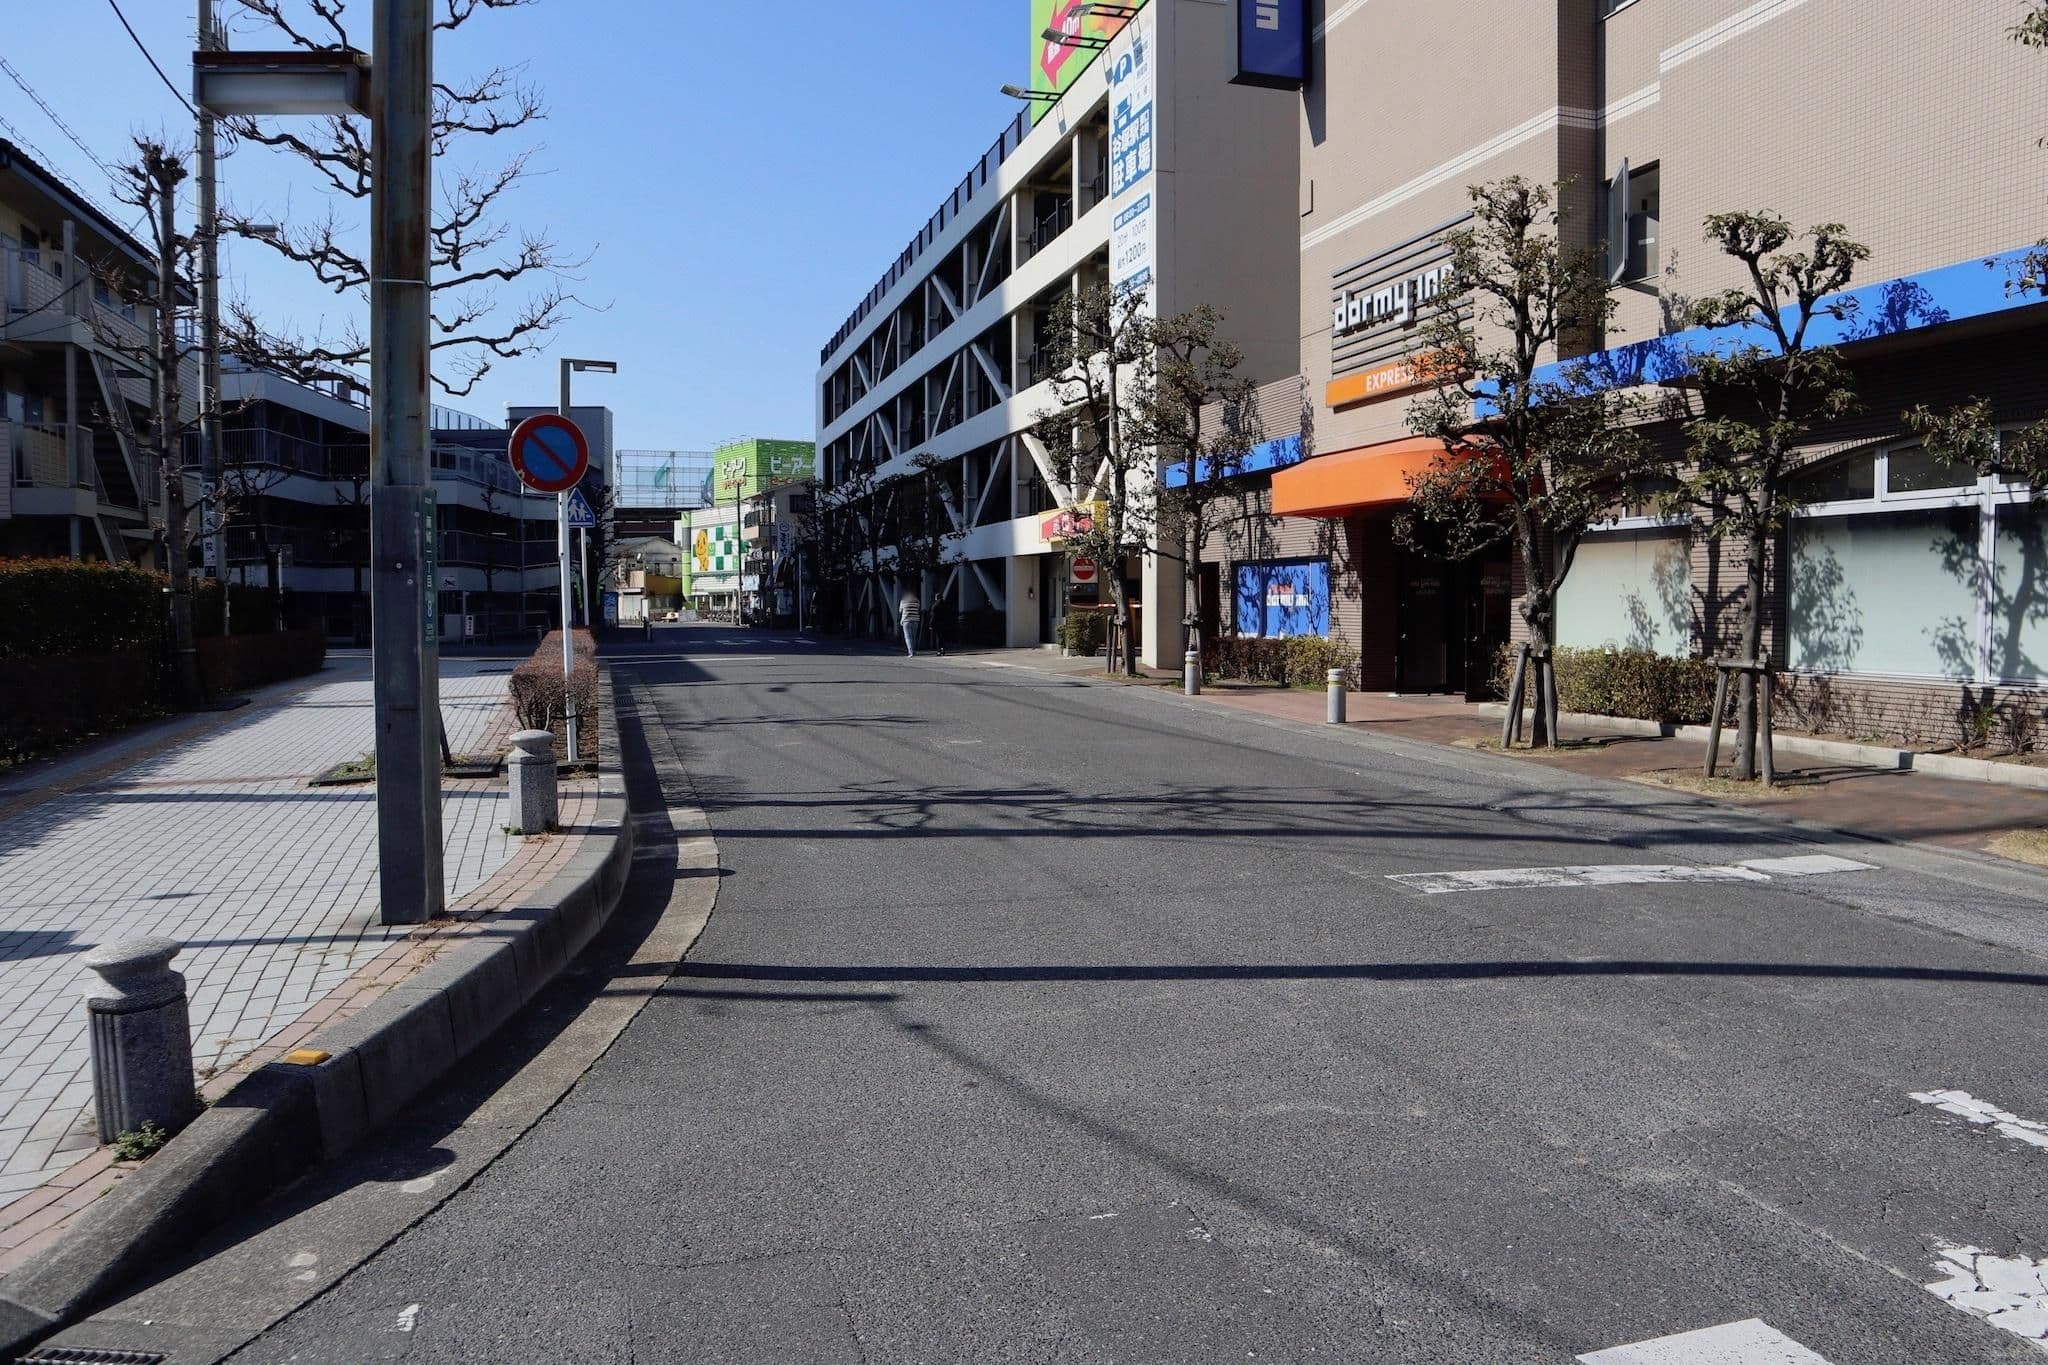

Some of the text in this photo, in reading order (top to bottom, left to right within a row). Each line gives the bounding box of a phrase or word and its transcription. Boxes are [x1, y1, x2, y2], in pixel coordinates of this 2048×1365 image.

[1112, 138, 1151, 195] 駐車場
[1335, 281, 1409, 331] dormy
